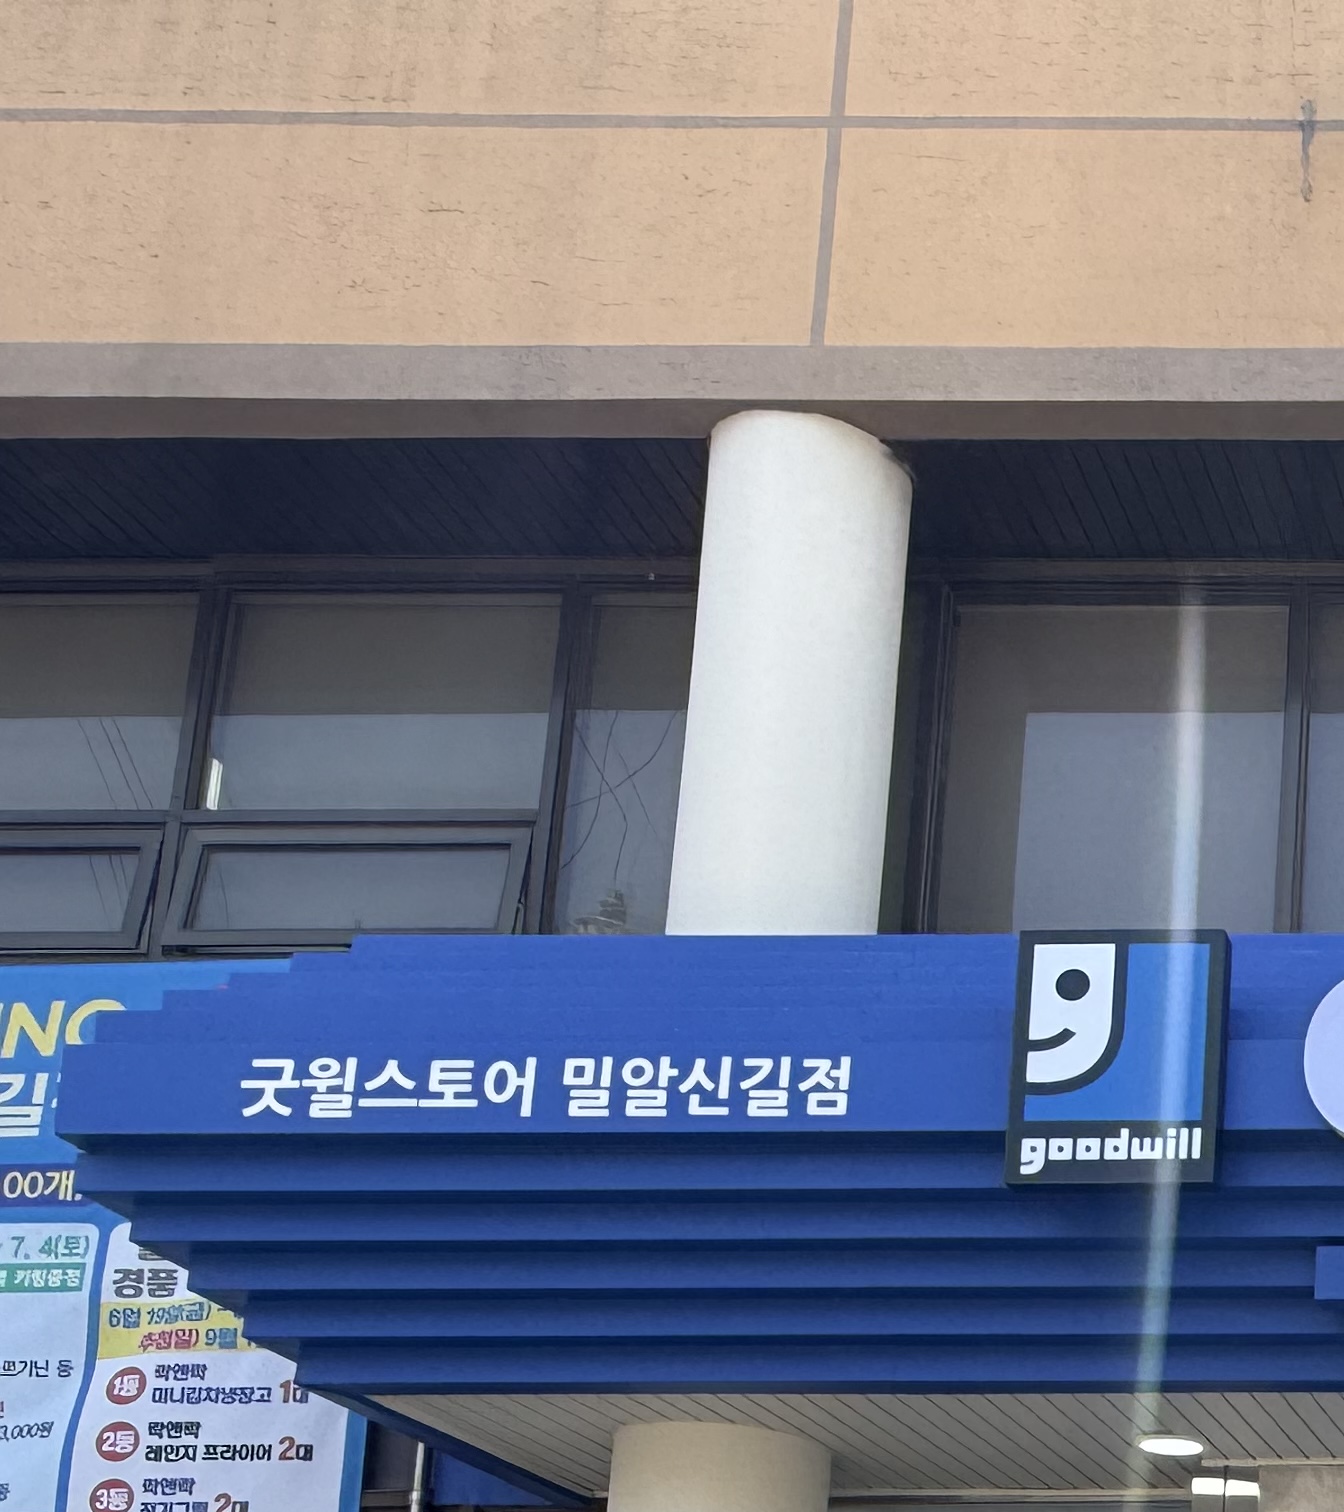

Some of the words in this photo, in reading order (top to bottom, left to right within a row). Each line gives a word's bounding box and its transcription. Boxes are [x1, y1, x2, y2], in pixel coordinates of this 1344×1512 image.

[240, 1057, 538, 1119] 굿윌스토어
[562, 1056, 852, 1119] 밀알신길점
[1020, 1127, 1202, 1175] goodwill
[112, 1268, 179, 1298] 경품
